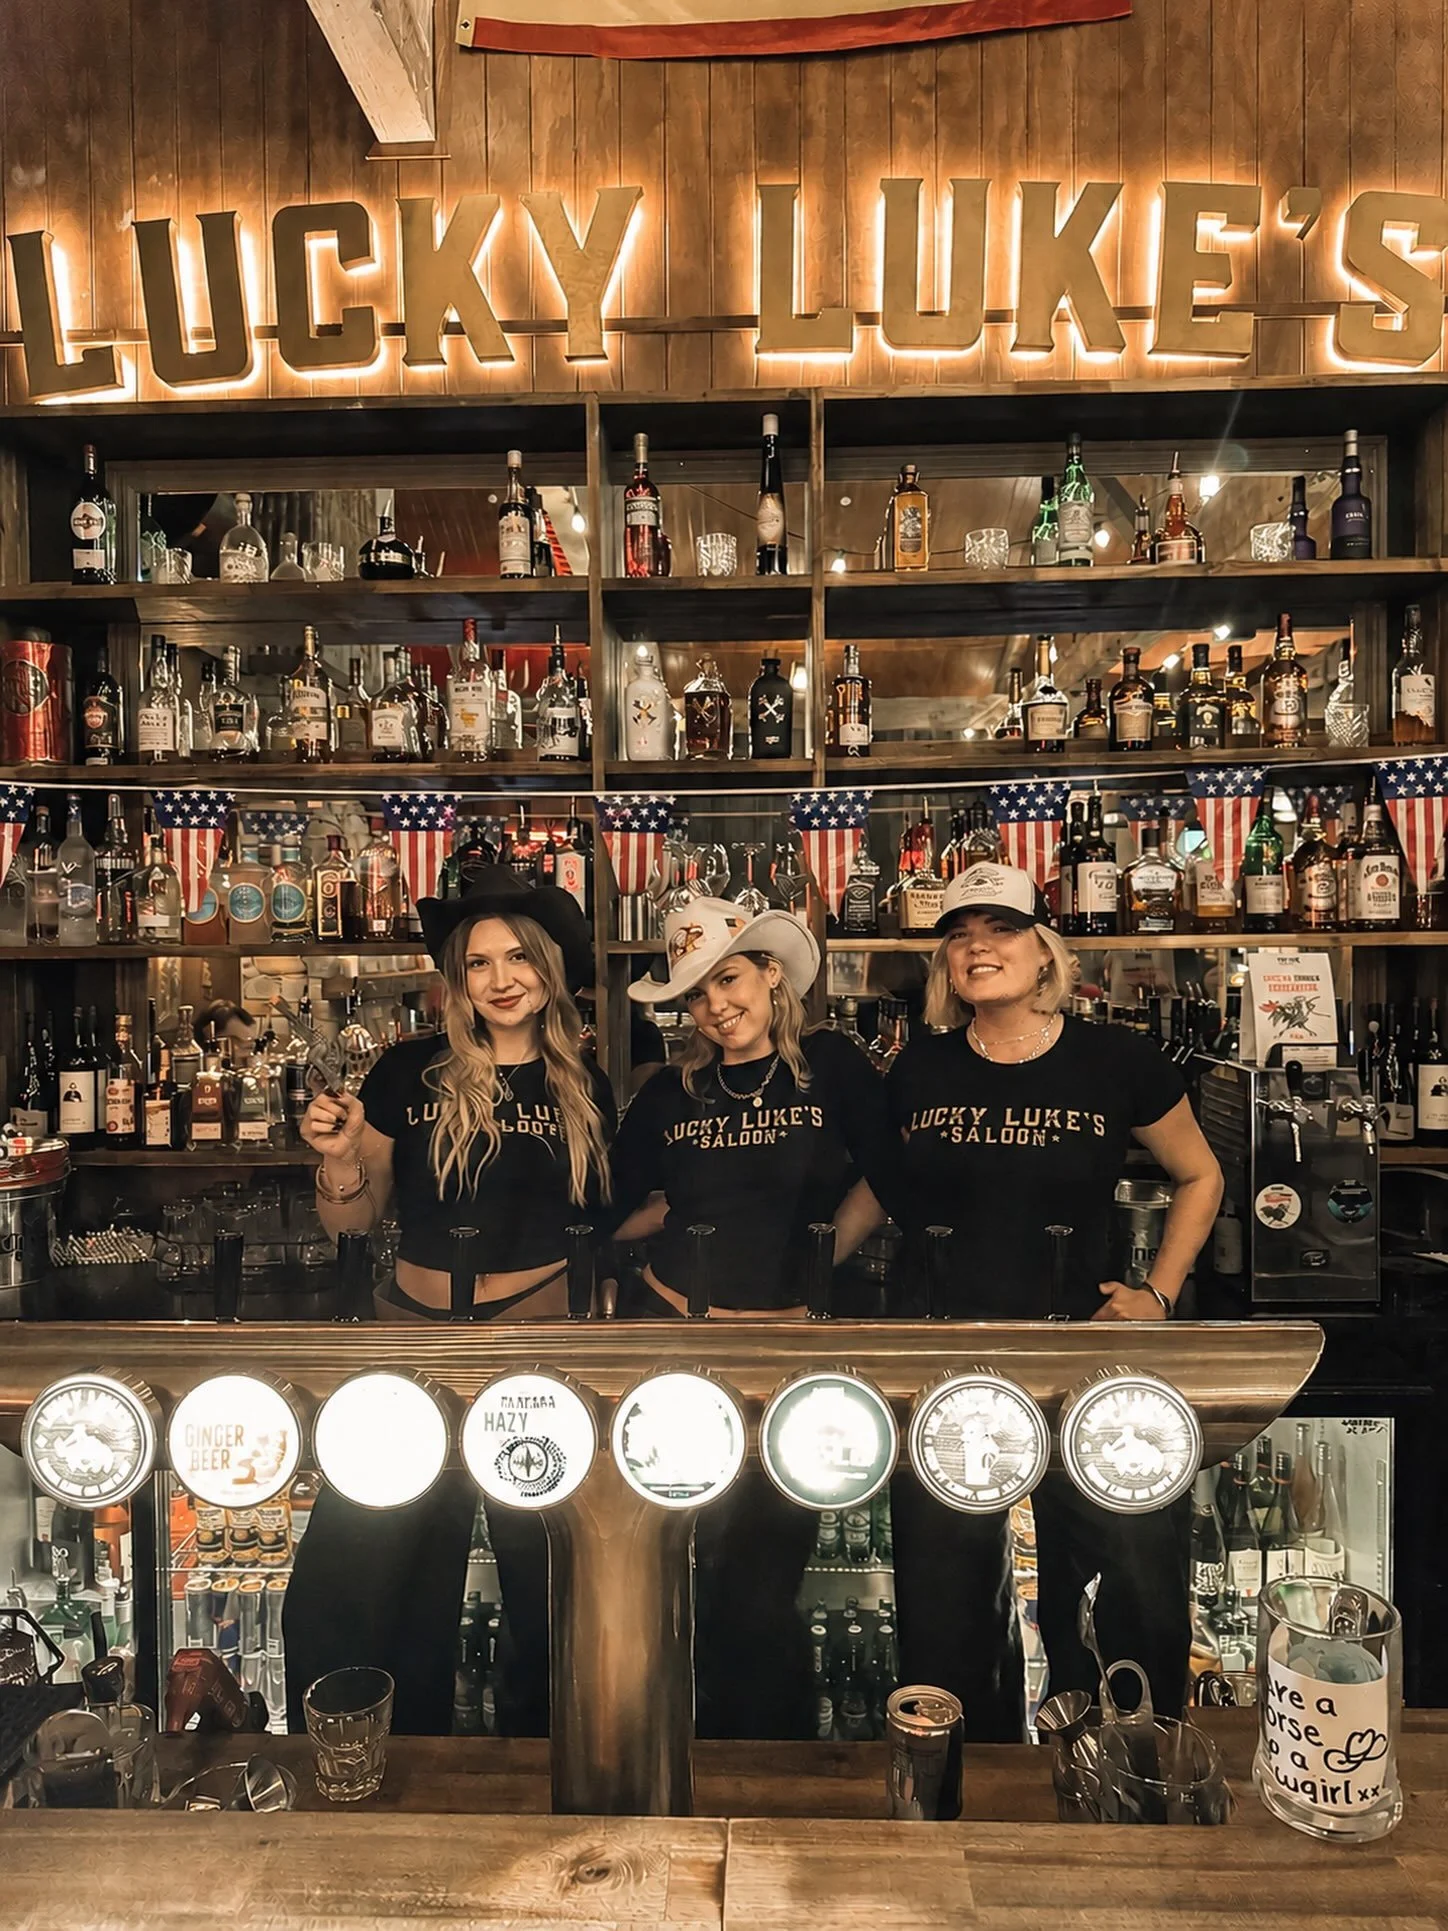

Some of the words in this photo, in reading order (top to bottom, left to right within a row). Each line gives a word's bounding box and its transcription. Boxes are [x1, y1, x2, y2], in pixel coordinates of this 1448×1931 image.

[7, 186, 645, 397] LUCKY
[755, 178, 1448, 367] LUKE'S
[663, 1115, 731, 1146] LUCKY
[741, 1105, 824, 1130] LUKE'S
[911, 1107, 988, 1132] LUCKY
[1005, 1107, 1106, 1137] LUKE'S
[700, 1128, 777, 1149] SALOON
[951, 1127, 1047, 1147] SALOON
[484, 1411, 528, 1432] HAZY
[185, 1423, 244, 1448] GINGER
[190, 1449, 231, 1472] BEER
[1316, 1697, 1338, 1717] a
[1266, 1704, 1325, 1747] orse
[1290, 1751, 1309, 1771] a
